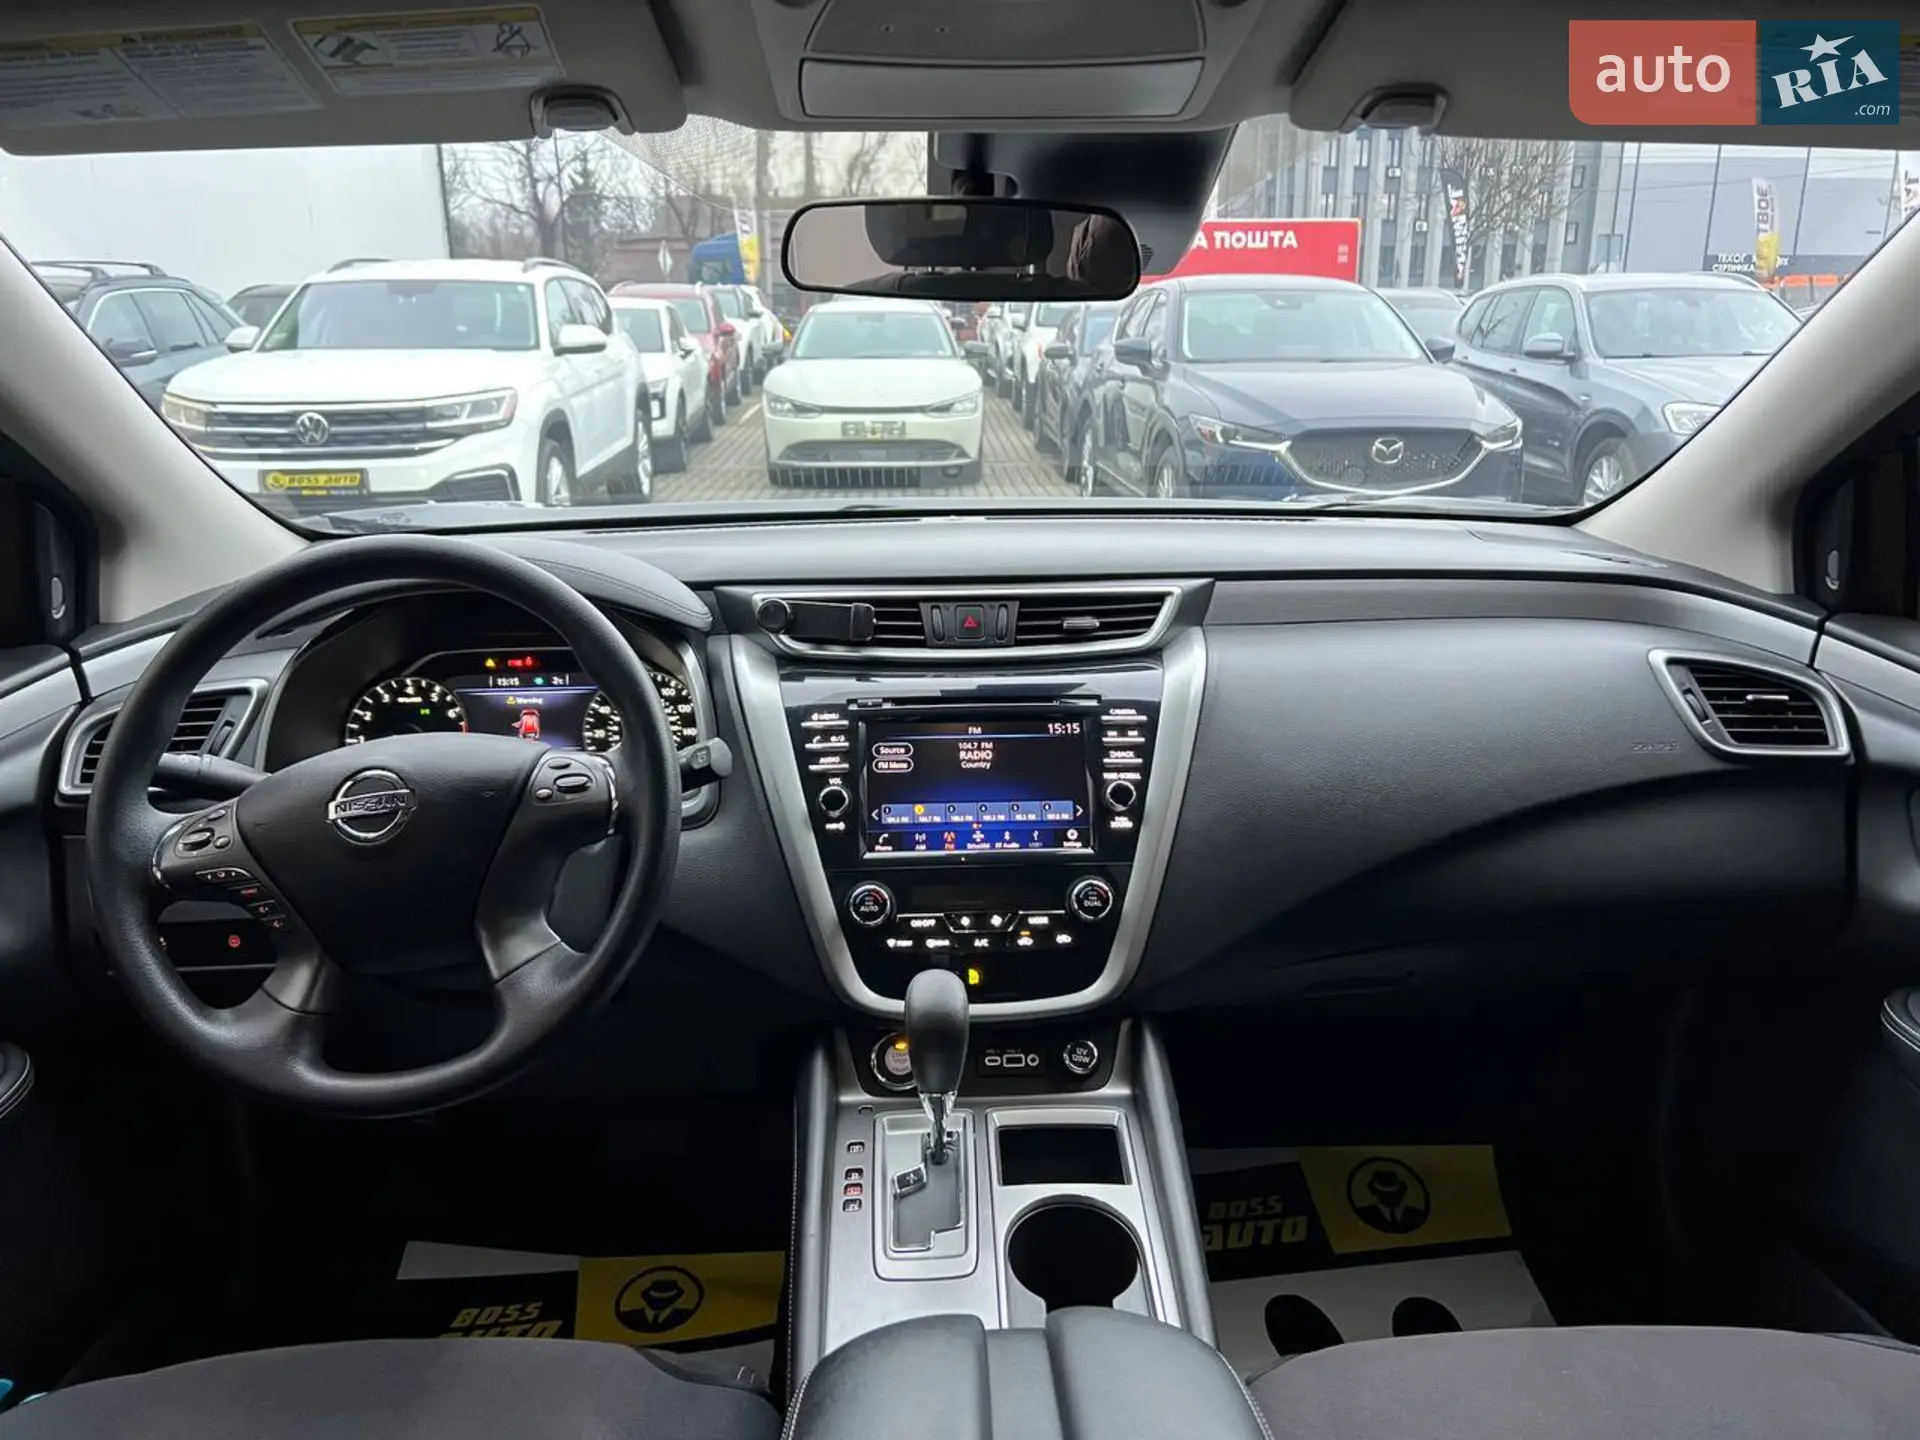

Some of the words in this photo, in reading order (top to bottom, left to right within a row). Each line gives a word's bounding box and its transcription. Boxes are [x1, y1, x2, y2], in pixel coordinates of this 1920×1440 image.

[1213, 230, 1298, 249] ПОШТА
[382, 693, 390, 703] 3
[430, 692, 439, 702] 5
[448, 709, 457, 719] 6
[968, 726, 983, 735] FM
[1047, 722, 1081, 735] 15:15
[879, 746, 906, 755] Source
[958, 742, 978, 750] 104.7
[959, 750, 992, 760] RADIO
[961, 760, 991, 770] Country
[336, 794, 407, 815] NISSAN
[1207, 1194, 1284, 1220] BOSS
[448, 1300, 544, 1328] BOSS
